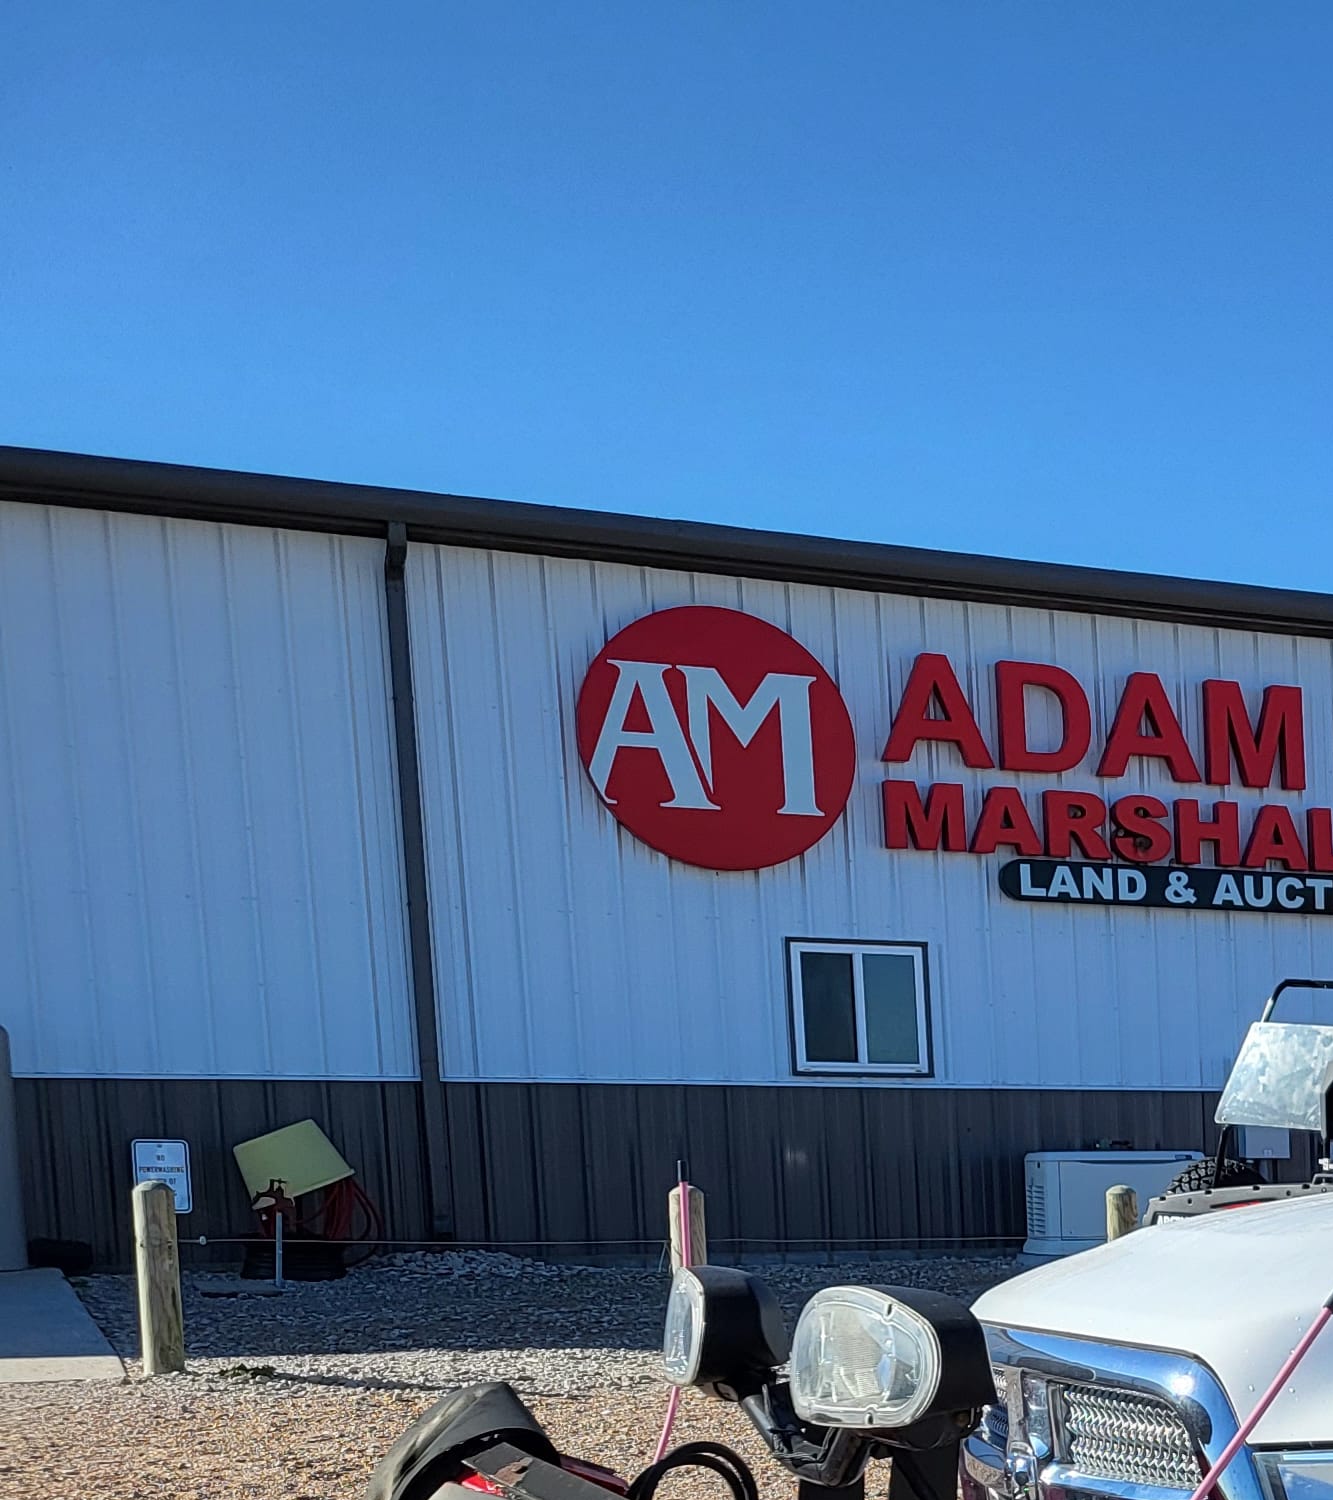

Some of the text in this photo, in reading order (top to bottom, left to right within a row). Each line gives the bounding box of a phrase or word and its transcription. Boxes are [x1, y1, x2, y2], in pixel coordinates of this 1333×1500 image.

[589, 659, 825, 816] AM
[881, 652, 1307, 791] ADAM
[1019, 863, 1148, 901] LAND
[1164, 870, 1197, 905] &
